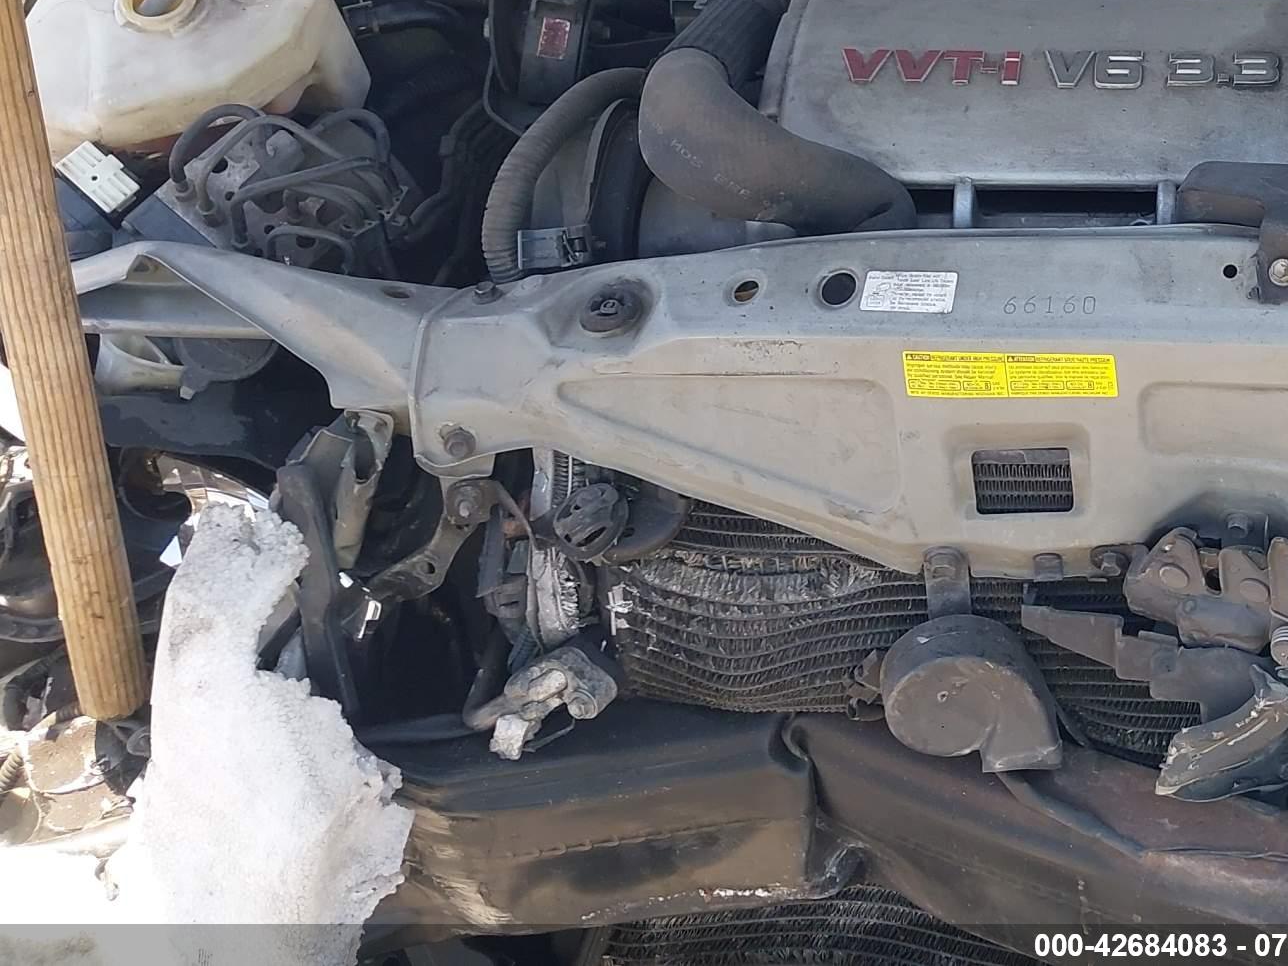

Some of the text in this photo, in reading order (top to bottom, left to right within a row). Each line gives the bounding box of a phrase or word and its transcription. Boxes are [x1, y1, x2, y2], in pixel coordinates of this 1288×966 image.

[842, 48, 1281, 90] VVT-i V6 3.3
[1003, 295, 1096, 315] 66160
